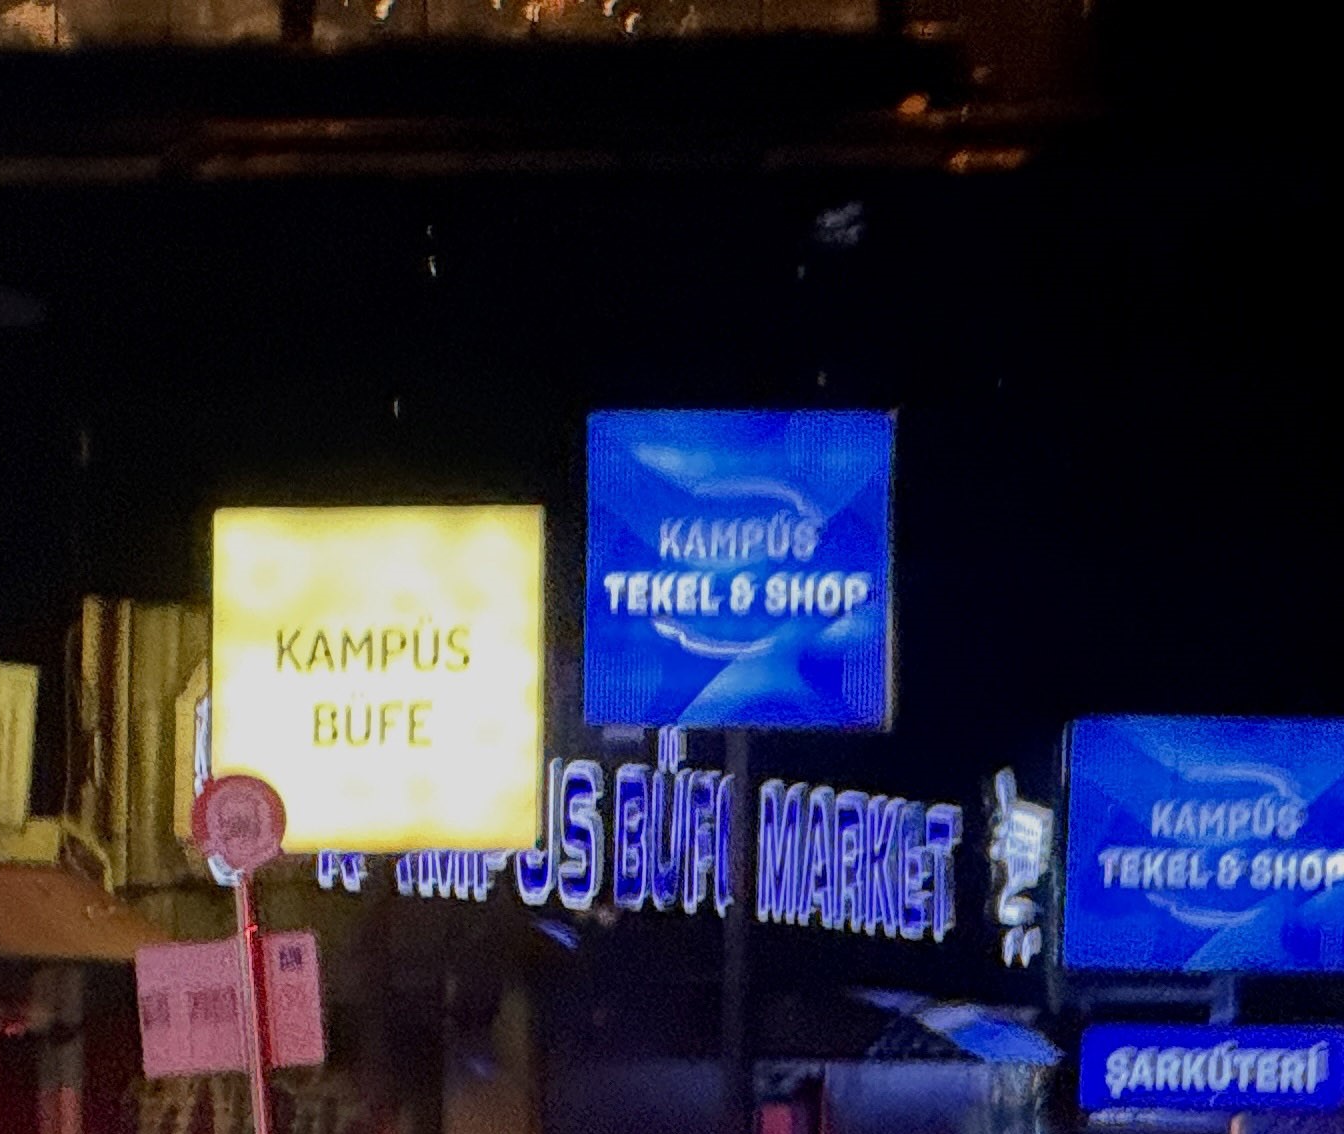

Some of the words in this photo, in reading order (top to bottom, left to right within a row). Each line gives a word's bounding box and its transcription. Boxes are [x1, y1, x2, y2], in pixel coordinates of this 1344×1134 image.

[659, 511, 822, 562] KAMPÜS
[604, 572, 722, 617] TEKEL
[729, 572, 757, 616] &
[764, 572, 872, 617] SHOP
[275, 613, 471, 672] KAMPÜS
[312, 690, 434, 747] BÜFE
[1150, 792, 1308, 841] KAMPÜS
[757, 778, 963, 943] MARKET
[1098, 848, 1211, 890] TEKEL
[1250, 848, 1344, 891] SHOP
[1105, 1040, 1328, 1099] ŞARKÜTERİ
